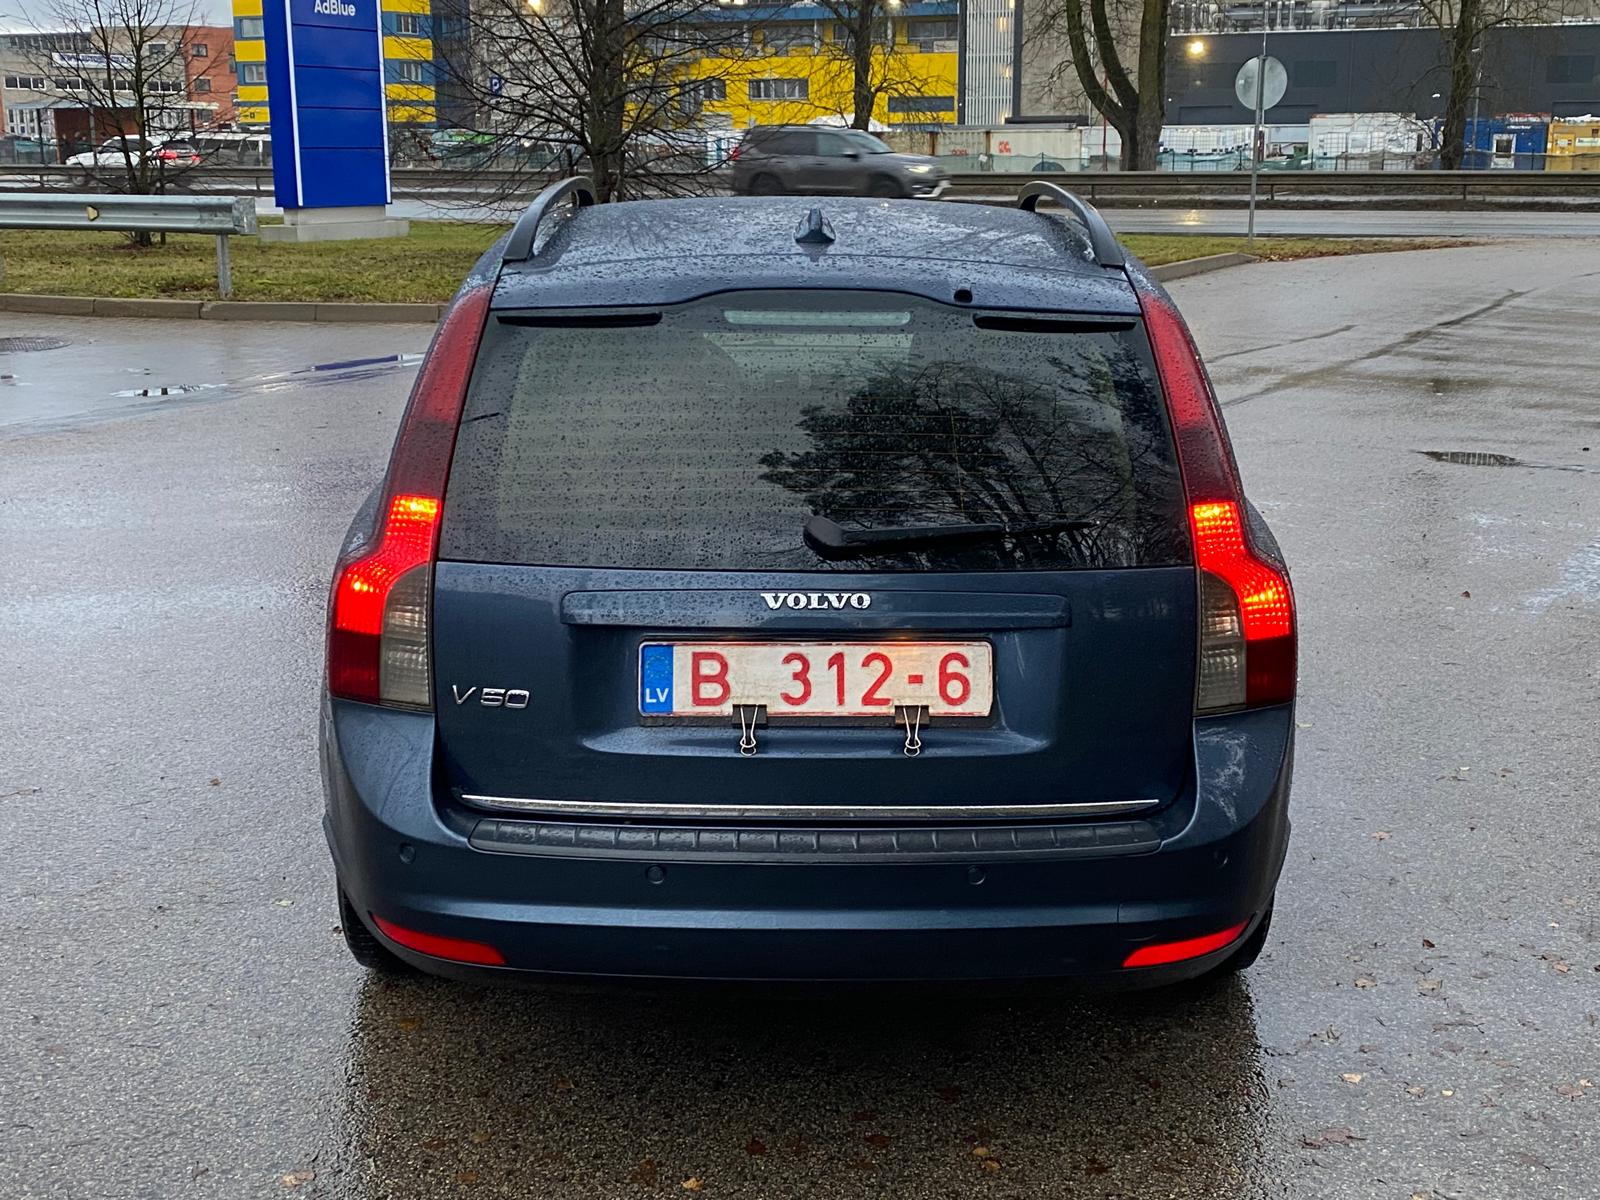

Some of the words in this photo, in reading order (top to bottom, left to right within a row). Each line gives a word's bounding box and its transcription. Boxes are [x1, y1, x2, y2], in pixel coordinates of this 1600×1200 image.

[314, 0, 356, 16] AdBlue
[761, 593, 871, 609] VOLVO
[692, 652, 730, 706] B
[780, 652, 971, 706] 312-6
[452, 684, 530, 708] V50
[645, 688, 669, 703] LV
